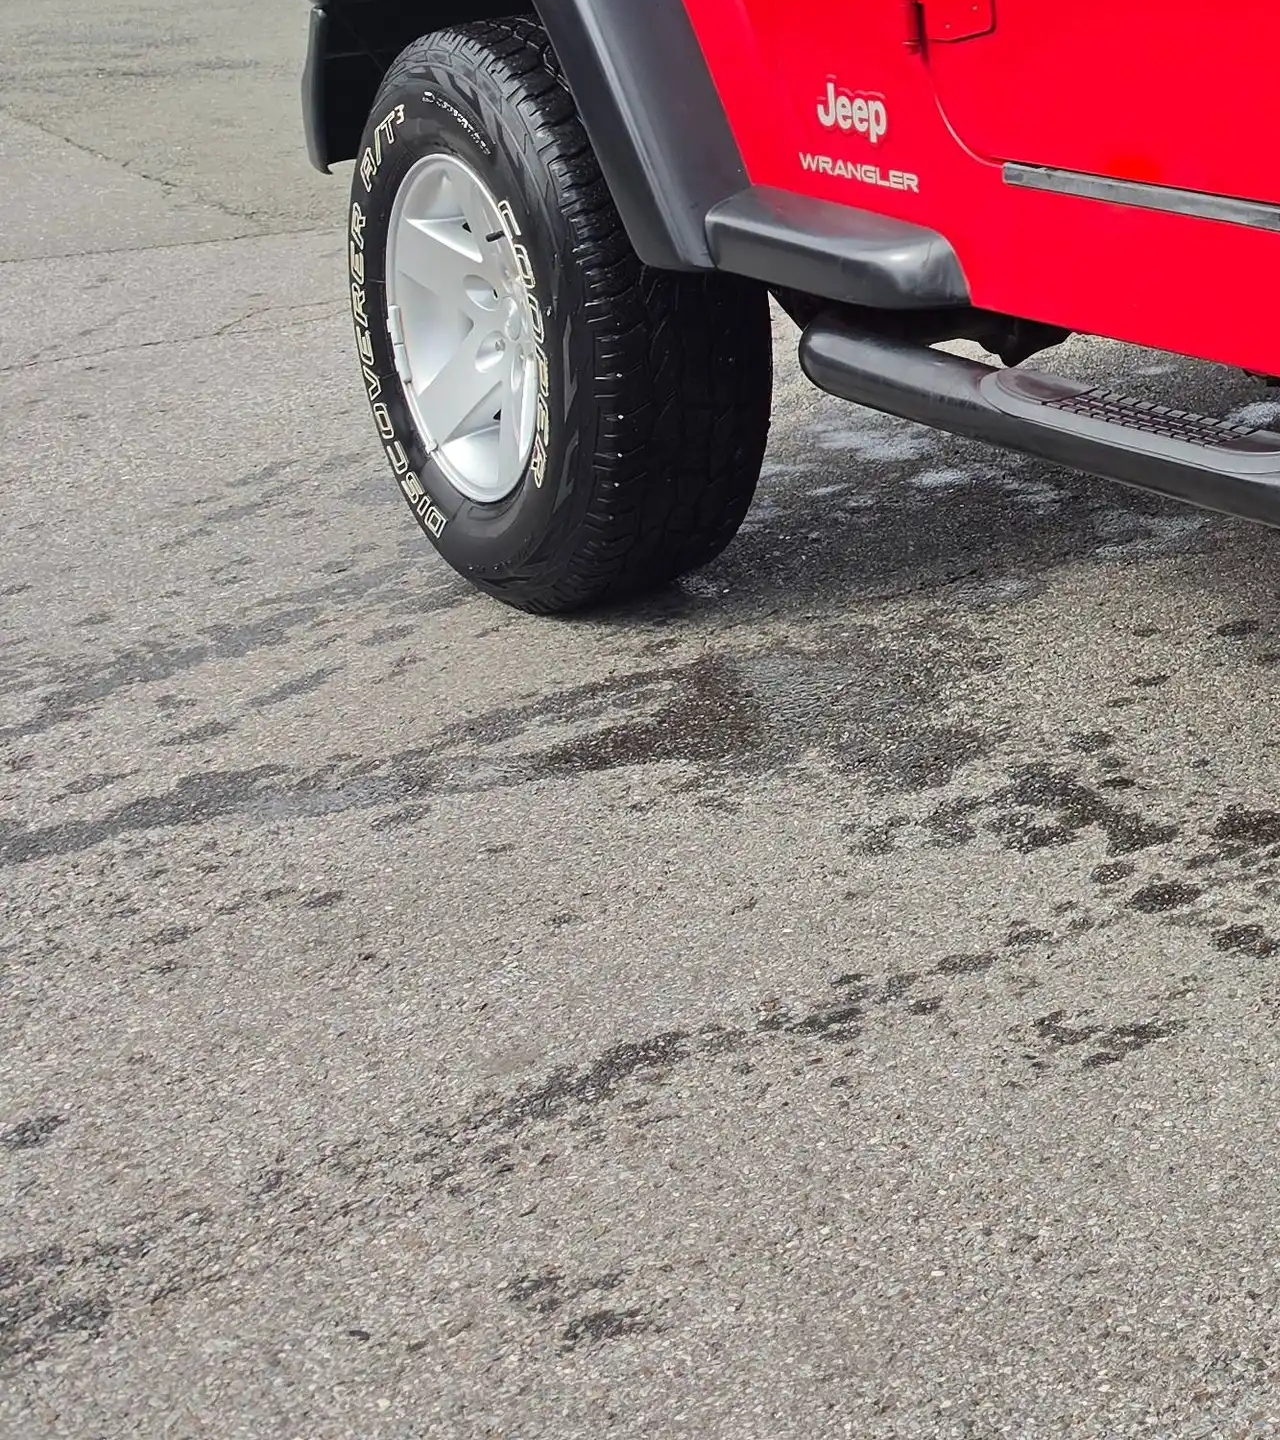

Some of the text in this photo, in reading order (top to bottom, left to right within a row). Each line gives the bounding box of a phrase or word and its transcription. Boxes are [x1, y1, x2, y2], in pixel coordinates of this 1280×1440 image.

[798, 151, 920, 194] WRANGLER
[816, 80, 888, 144] Jeep
[348, 202, 447, 538] DISCOVERER
[497, 199, 554, 489] COOPER
